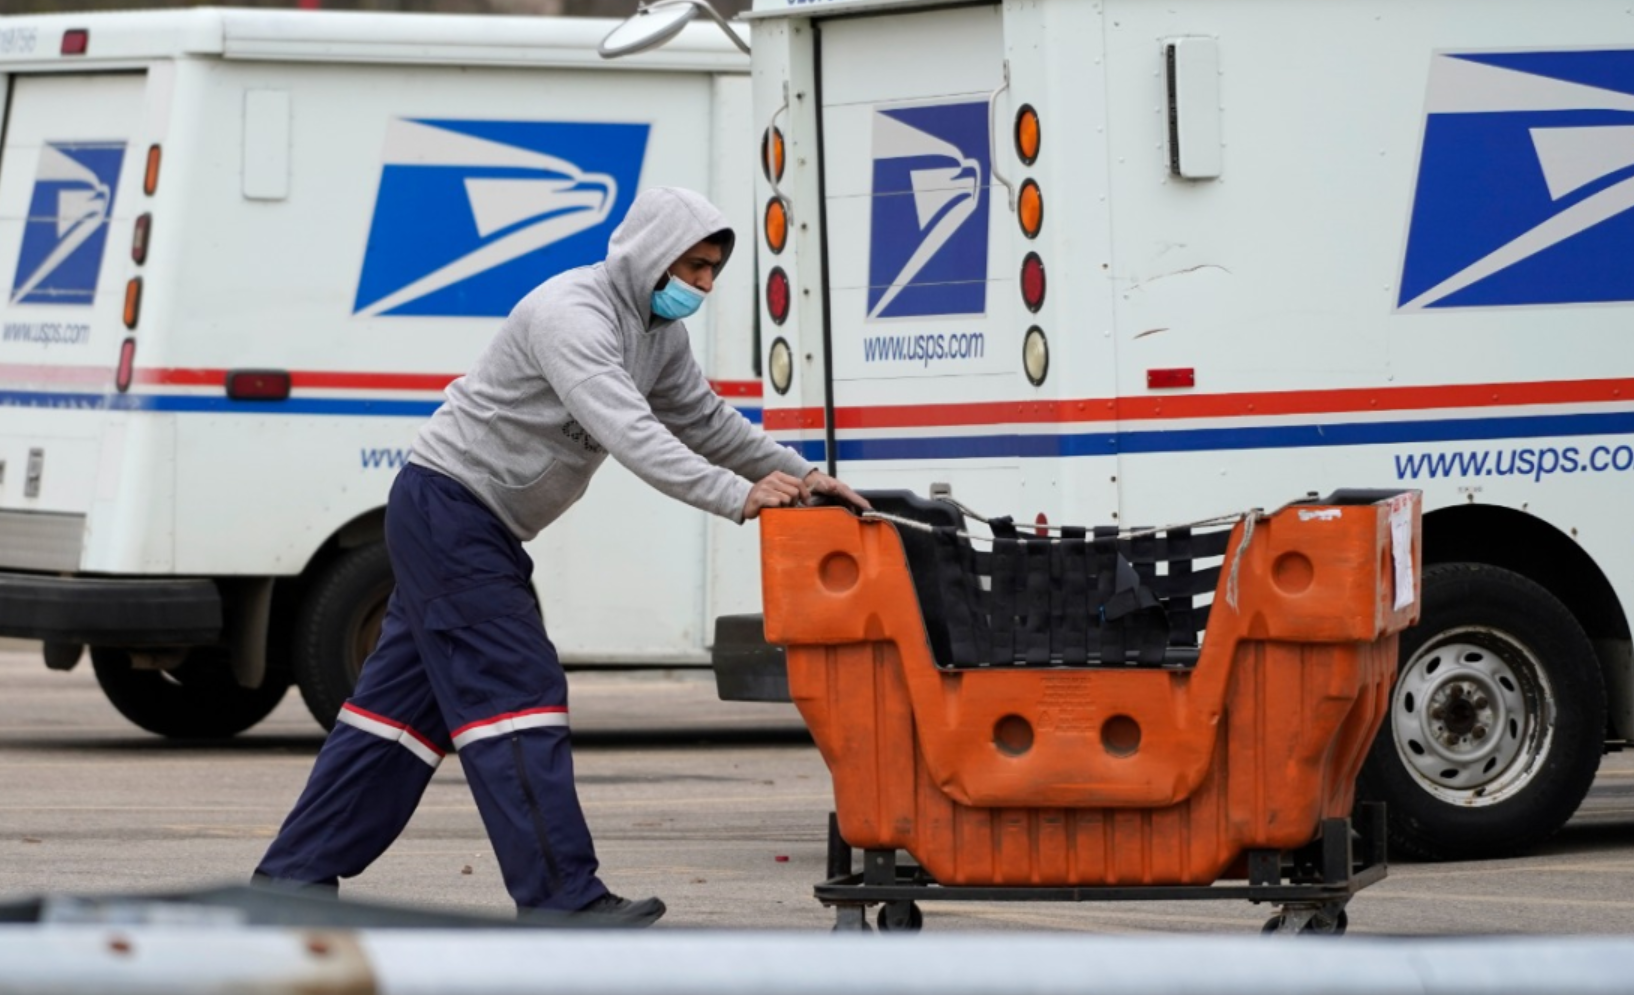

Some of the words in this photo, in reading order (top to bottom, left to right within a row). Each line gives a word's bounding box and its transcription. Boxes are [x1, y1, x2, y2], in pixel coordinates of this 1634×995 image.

[3, 322, 90, 349] www.usps.com
[863, 332, 984, 369] www.usps.com
[1395, 445, 1634, 483] www.usps.co
